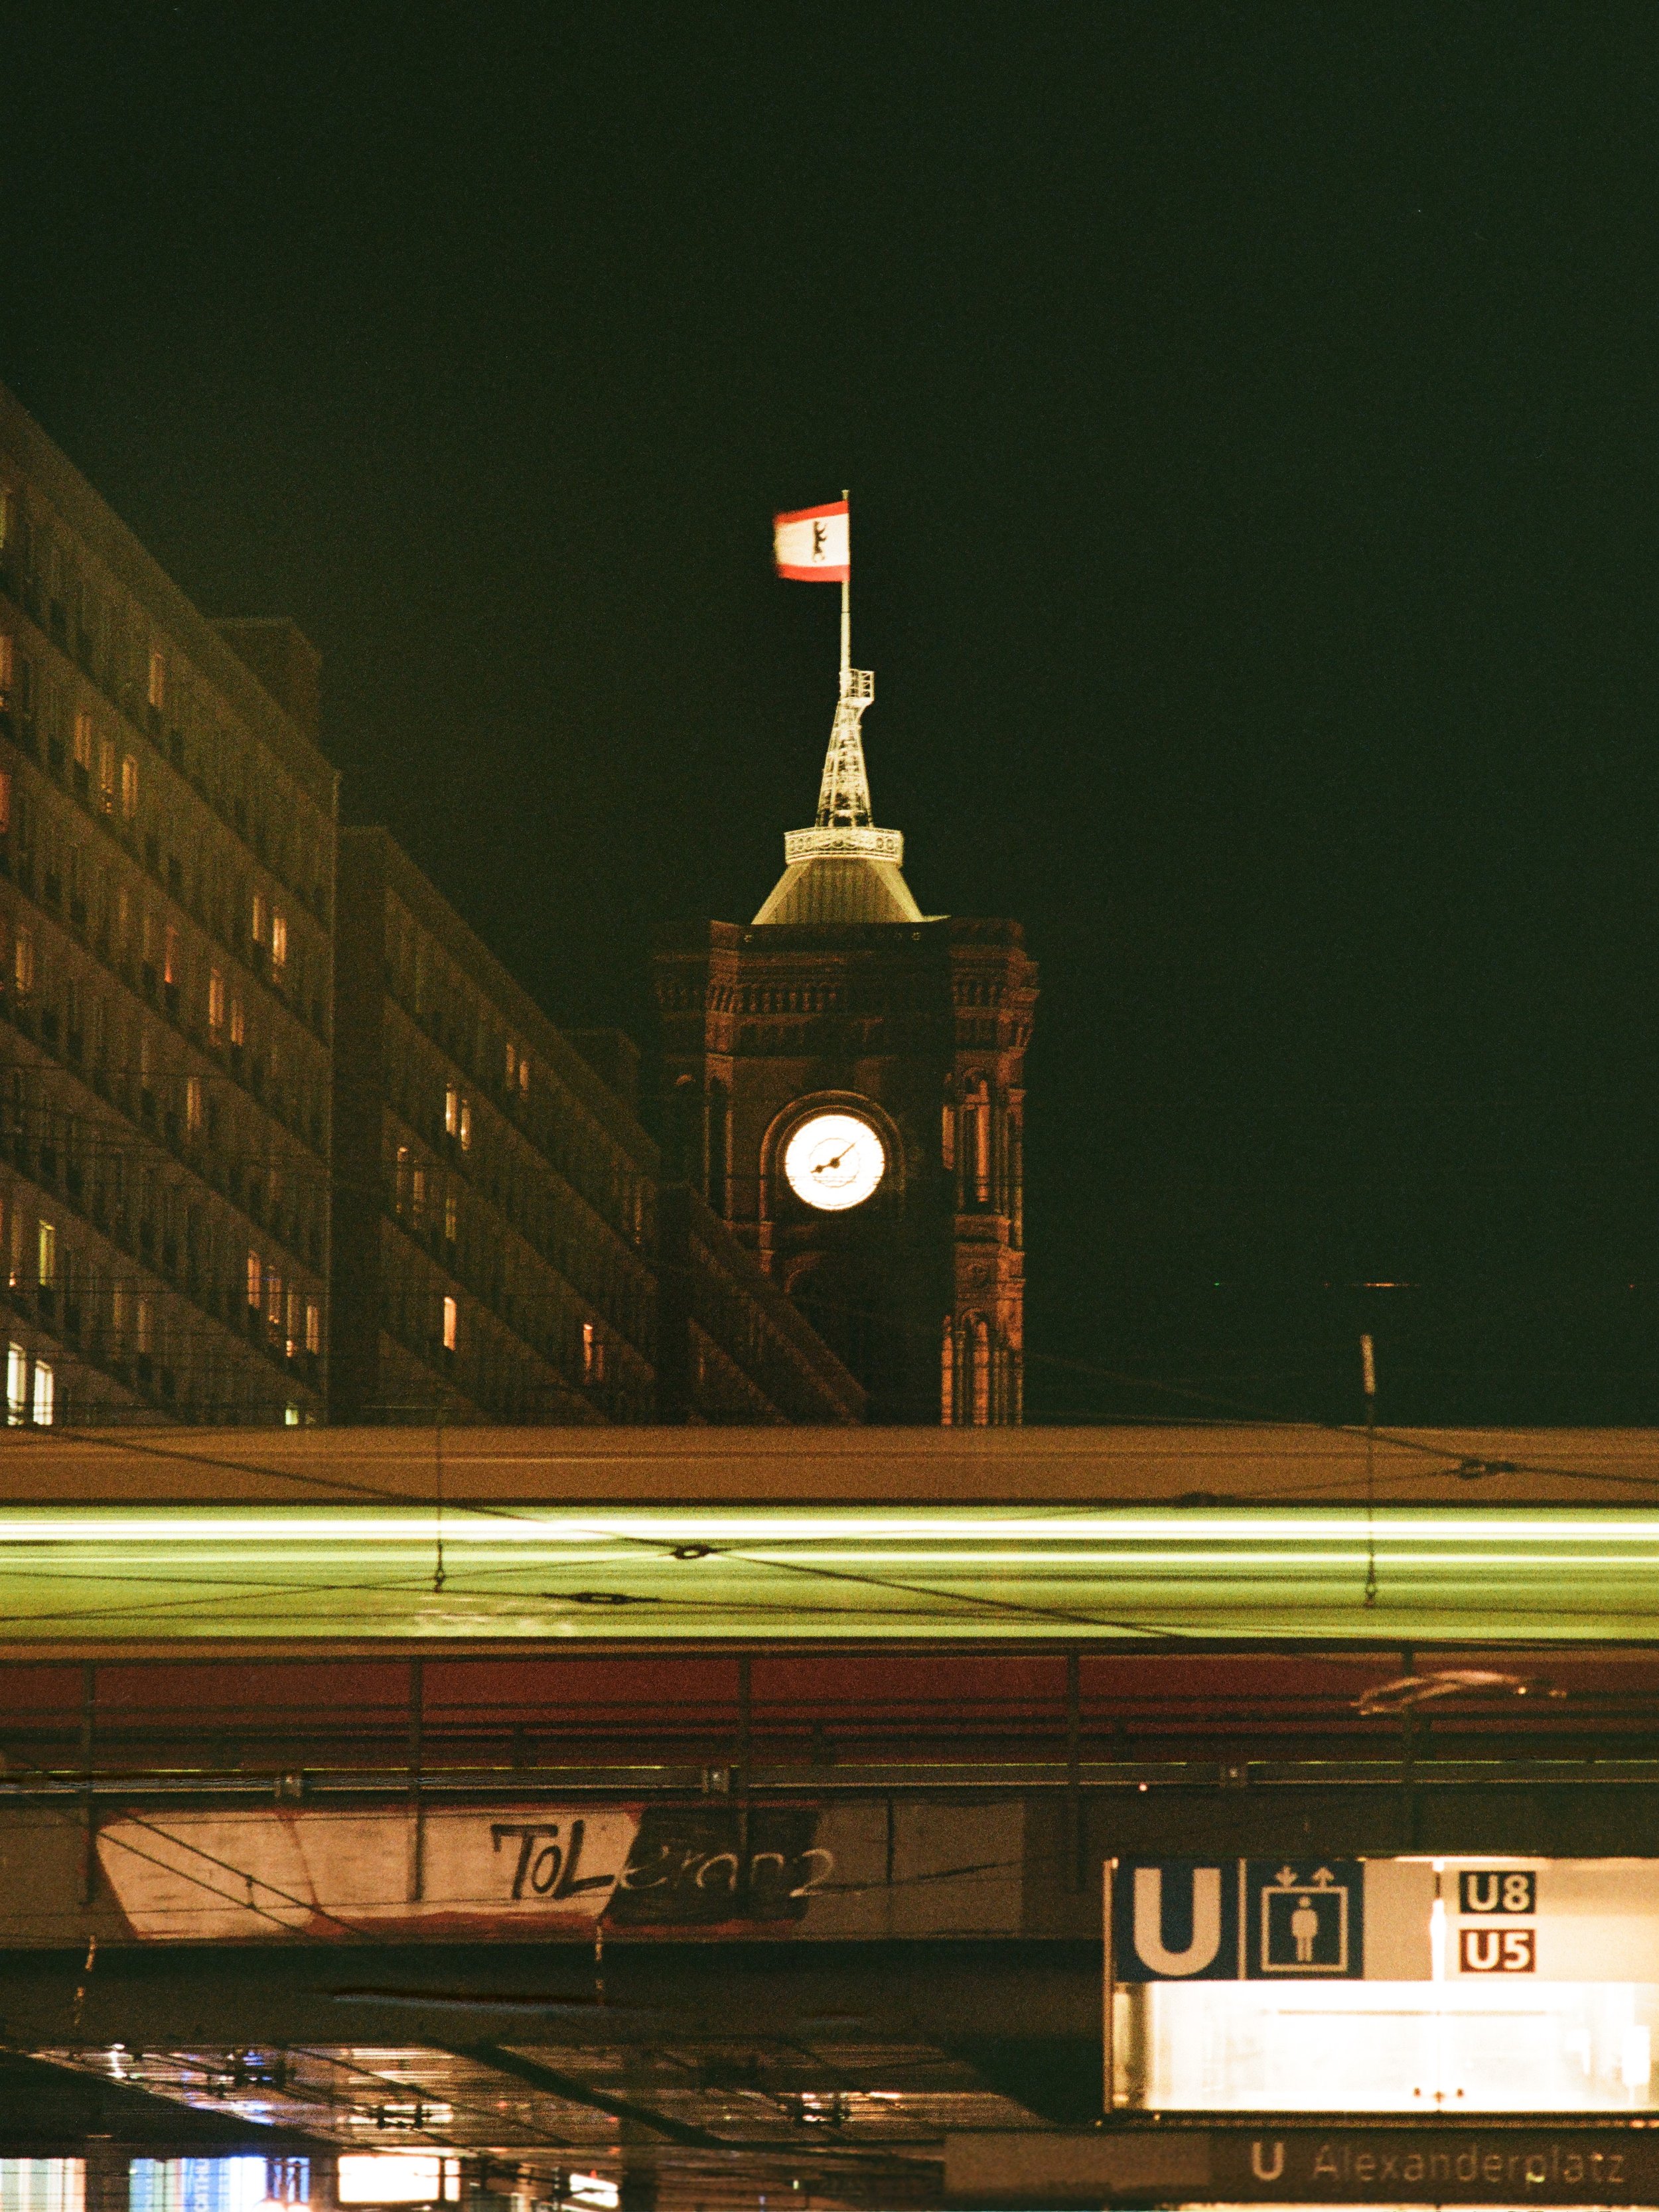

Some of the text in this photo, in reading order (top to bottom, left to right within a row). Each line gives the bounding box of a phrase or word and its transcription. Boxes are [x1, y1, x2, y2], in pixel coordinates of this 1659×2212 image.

[1467, 1874, 1530, 1911] U8
[1134, 1868, 1220, 1976] U
[1467, 1933, 1531, 1969] U5
[1252, 2142, 1624, 2189] U Alexanderplatz
